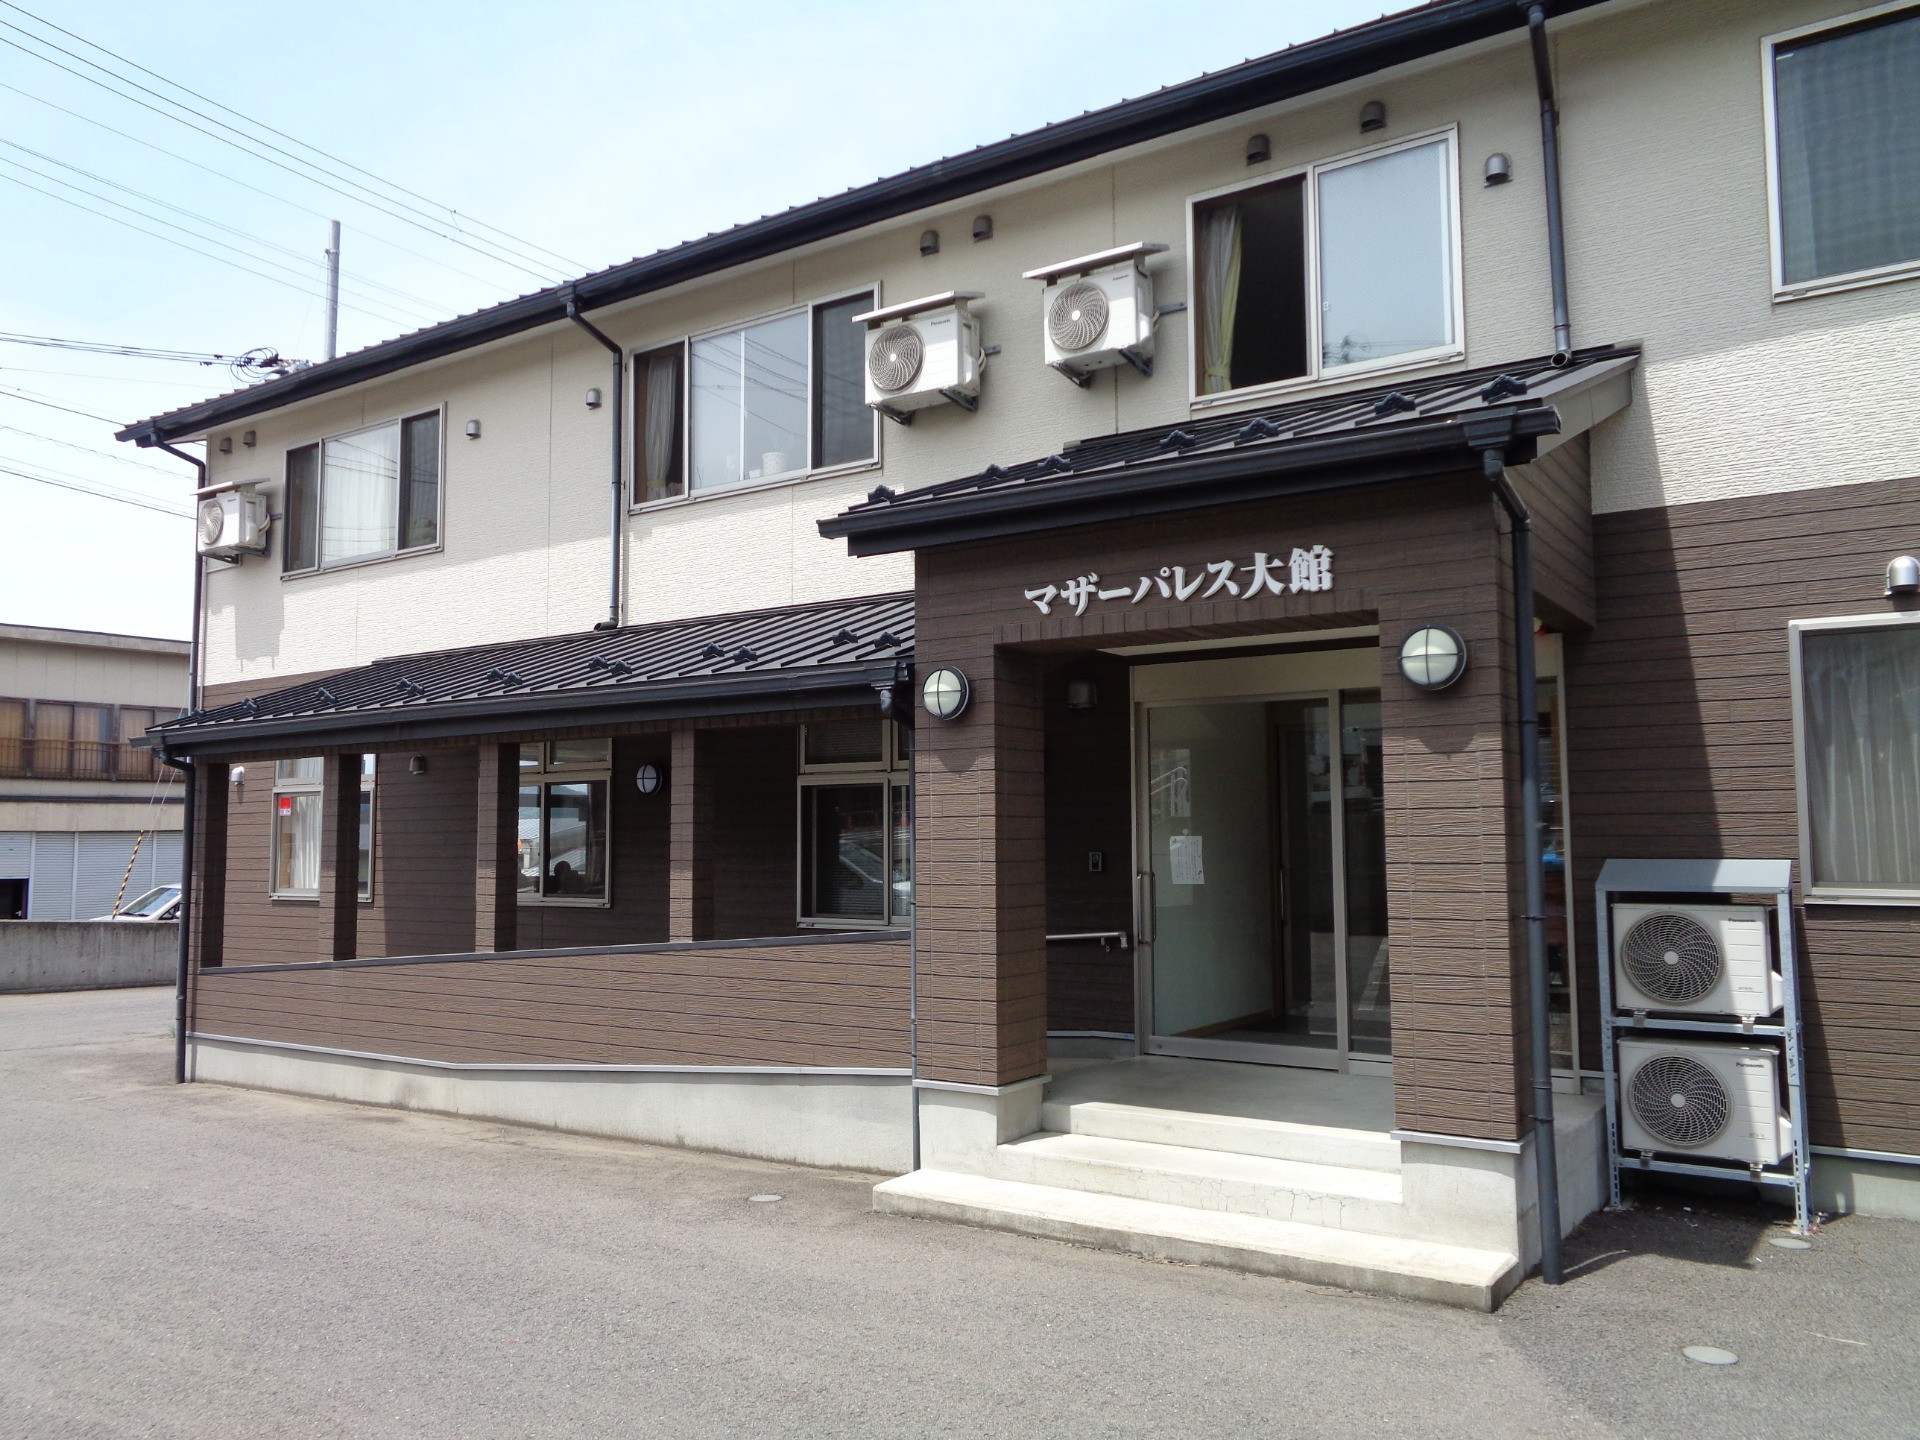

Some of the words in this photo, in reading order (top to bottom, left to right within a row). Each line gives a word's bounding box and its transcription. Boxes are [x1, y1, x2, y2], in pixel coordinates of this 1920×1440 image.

[1024, 544, 1334, 616] マザーパレス大館
[1735, 1061, 1765, 1069] Panasonic
